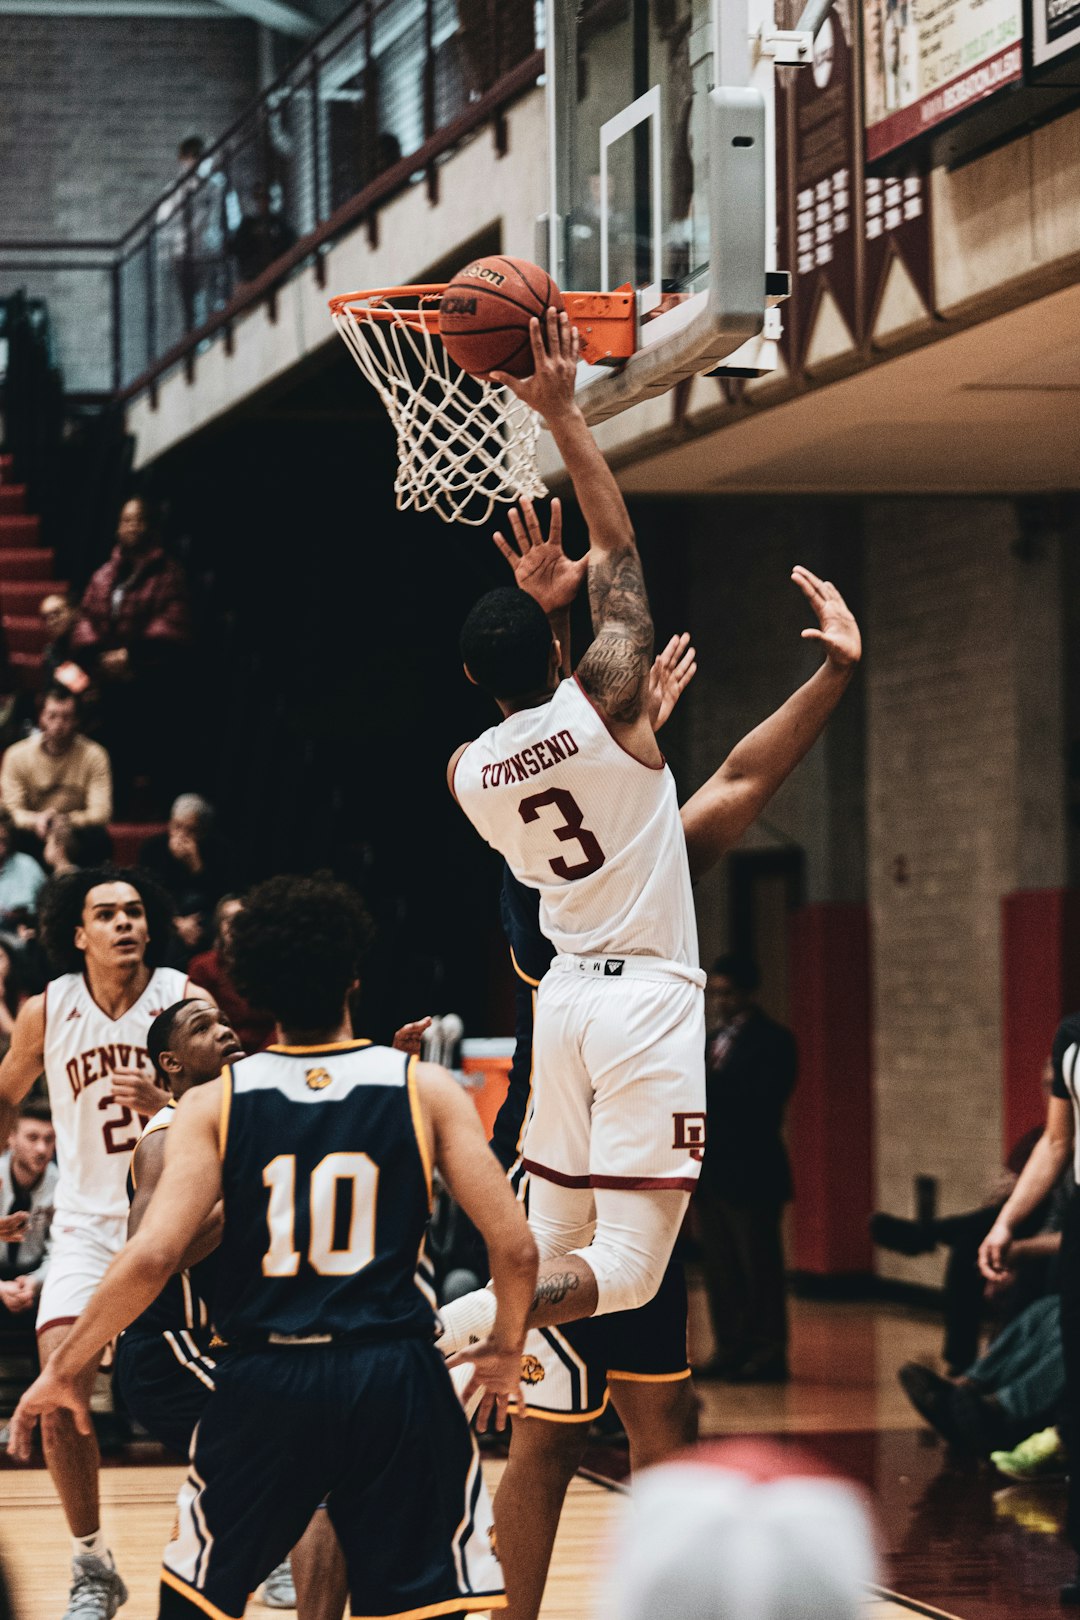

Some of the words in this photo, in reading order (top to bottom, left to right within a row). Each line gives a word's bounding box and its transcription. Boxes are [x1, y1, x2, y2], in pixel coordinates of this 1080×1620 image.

[462, 263, 506, 288] son
[481, 729, 579, 789] TOWNSEND
[518, 787, 605, 881] 3
[66, 1043, 165, 1102] DENVE
[98, 1095, 151, 1154] 2
[262, 1151, 380, 1277] 10
